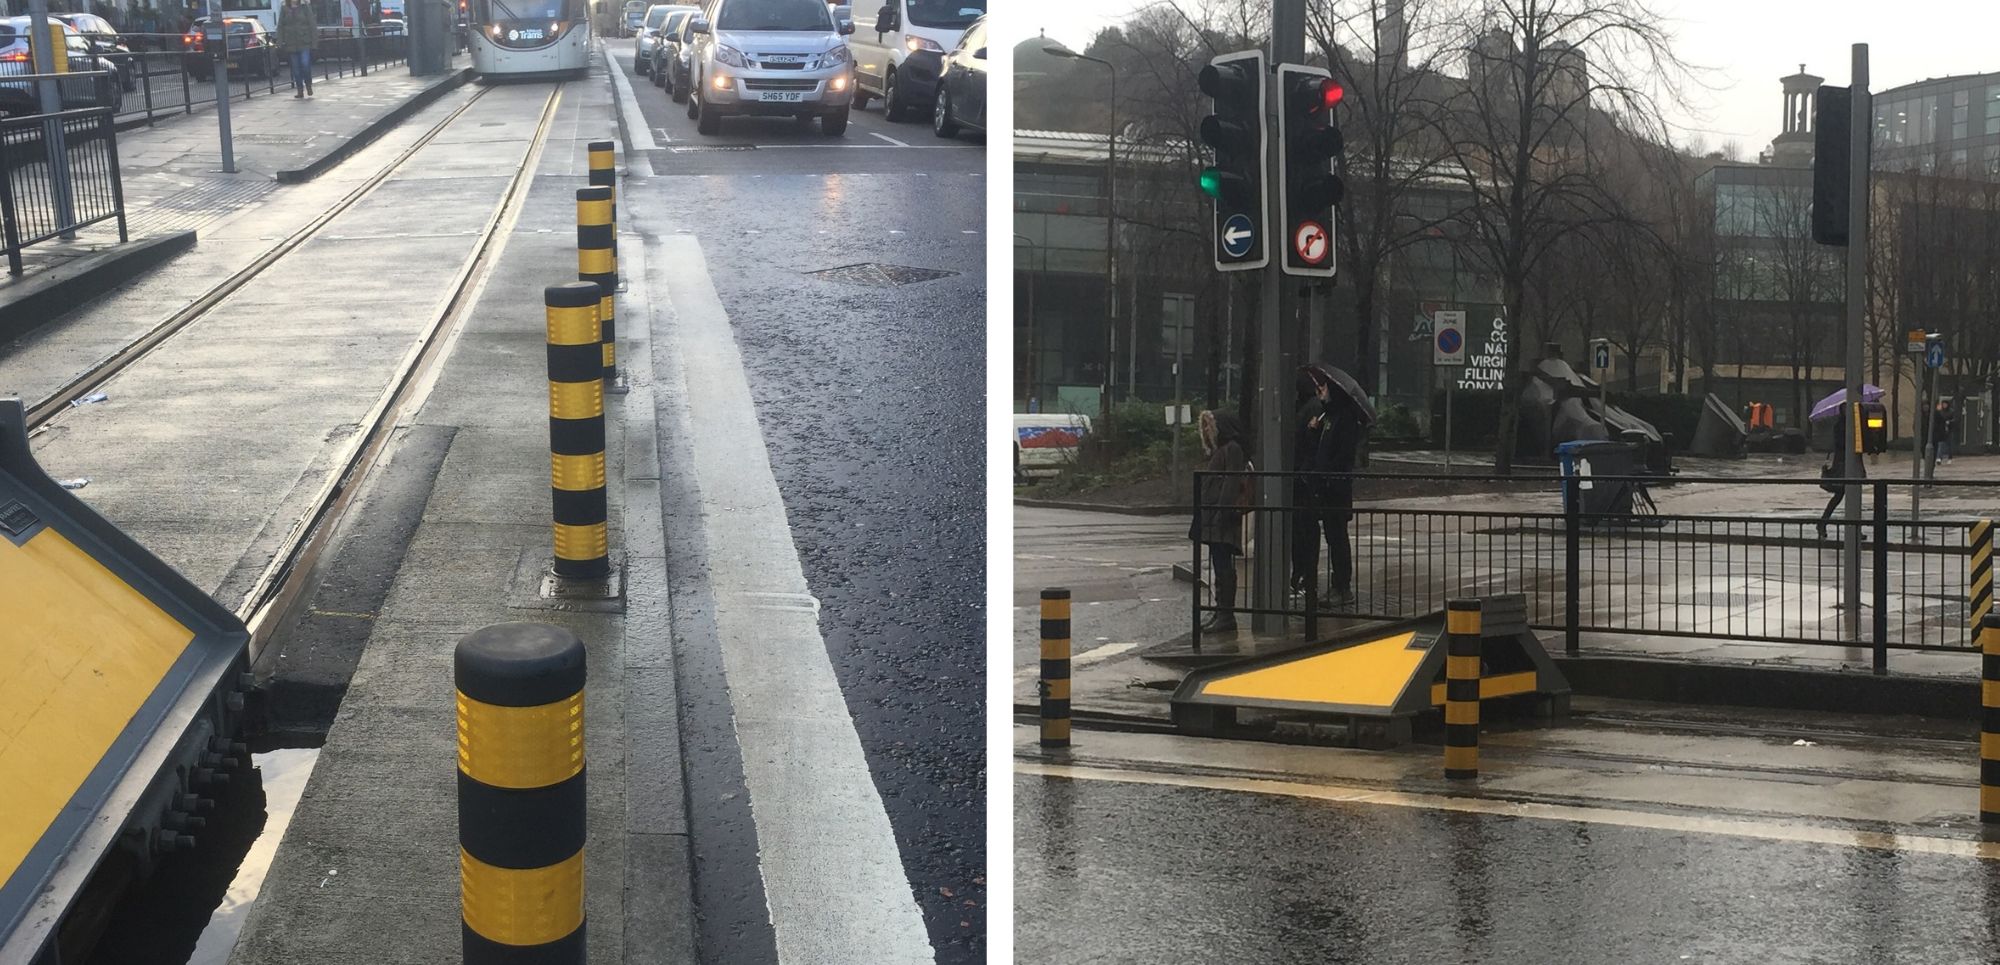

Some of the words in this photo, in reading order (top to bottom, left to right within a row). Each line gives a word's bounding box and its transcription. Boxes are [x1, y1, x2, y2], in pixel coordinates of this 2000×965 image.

[519, 30, 544, 39] Trams
[762, 92, 783, 101] SH65
[785, 92, 801, 101] YDF
